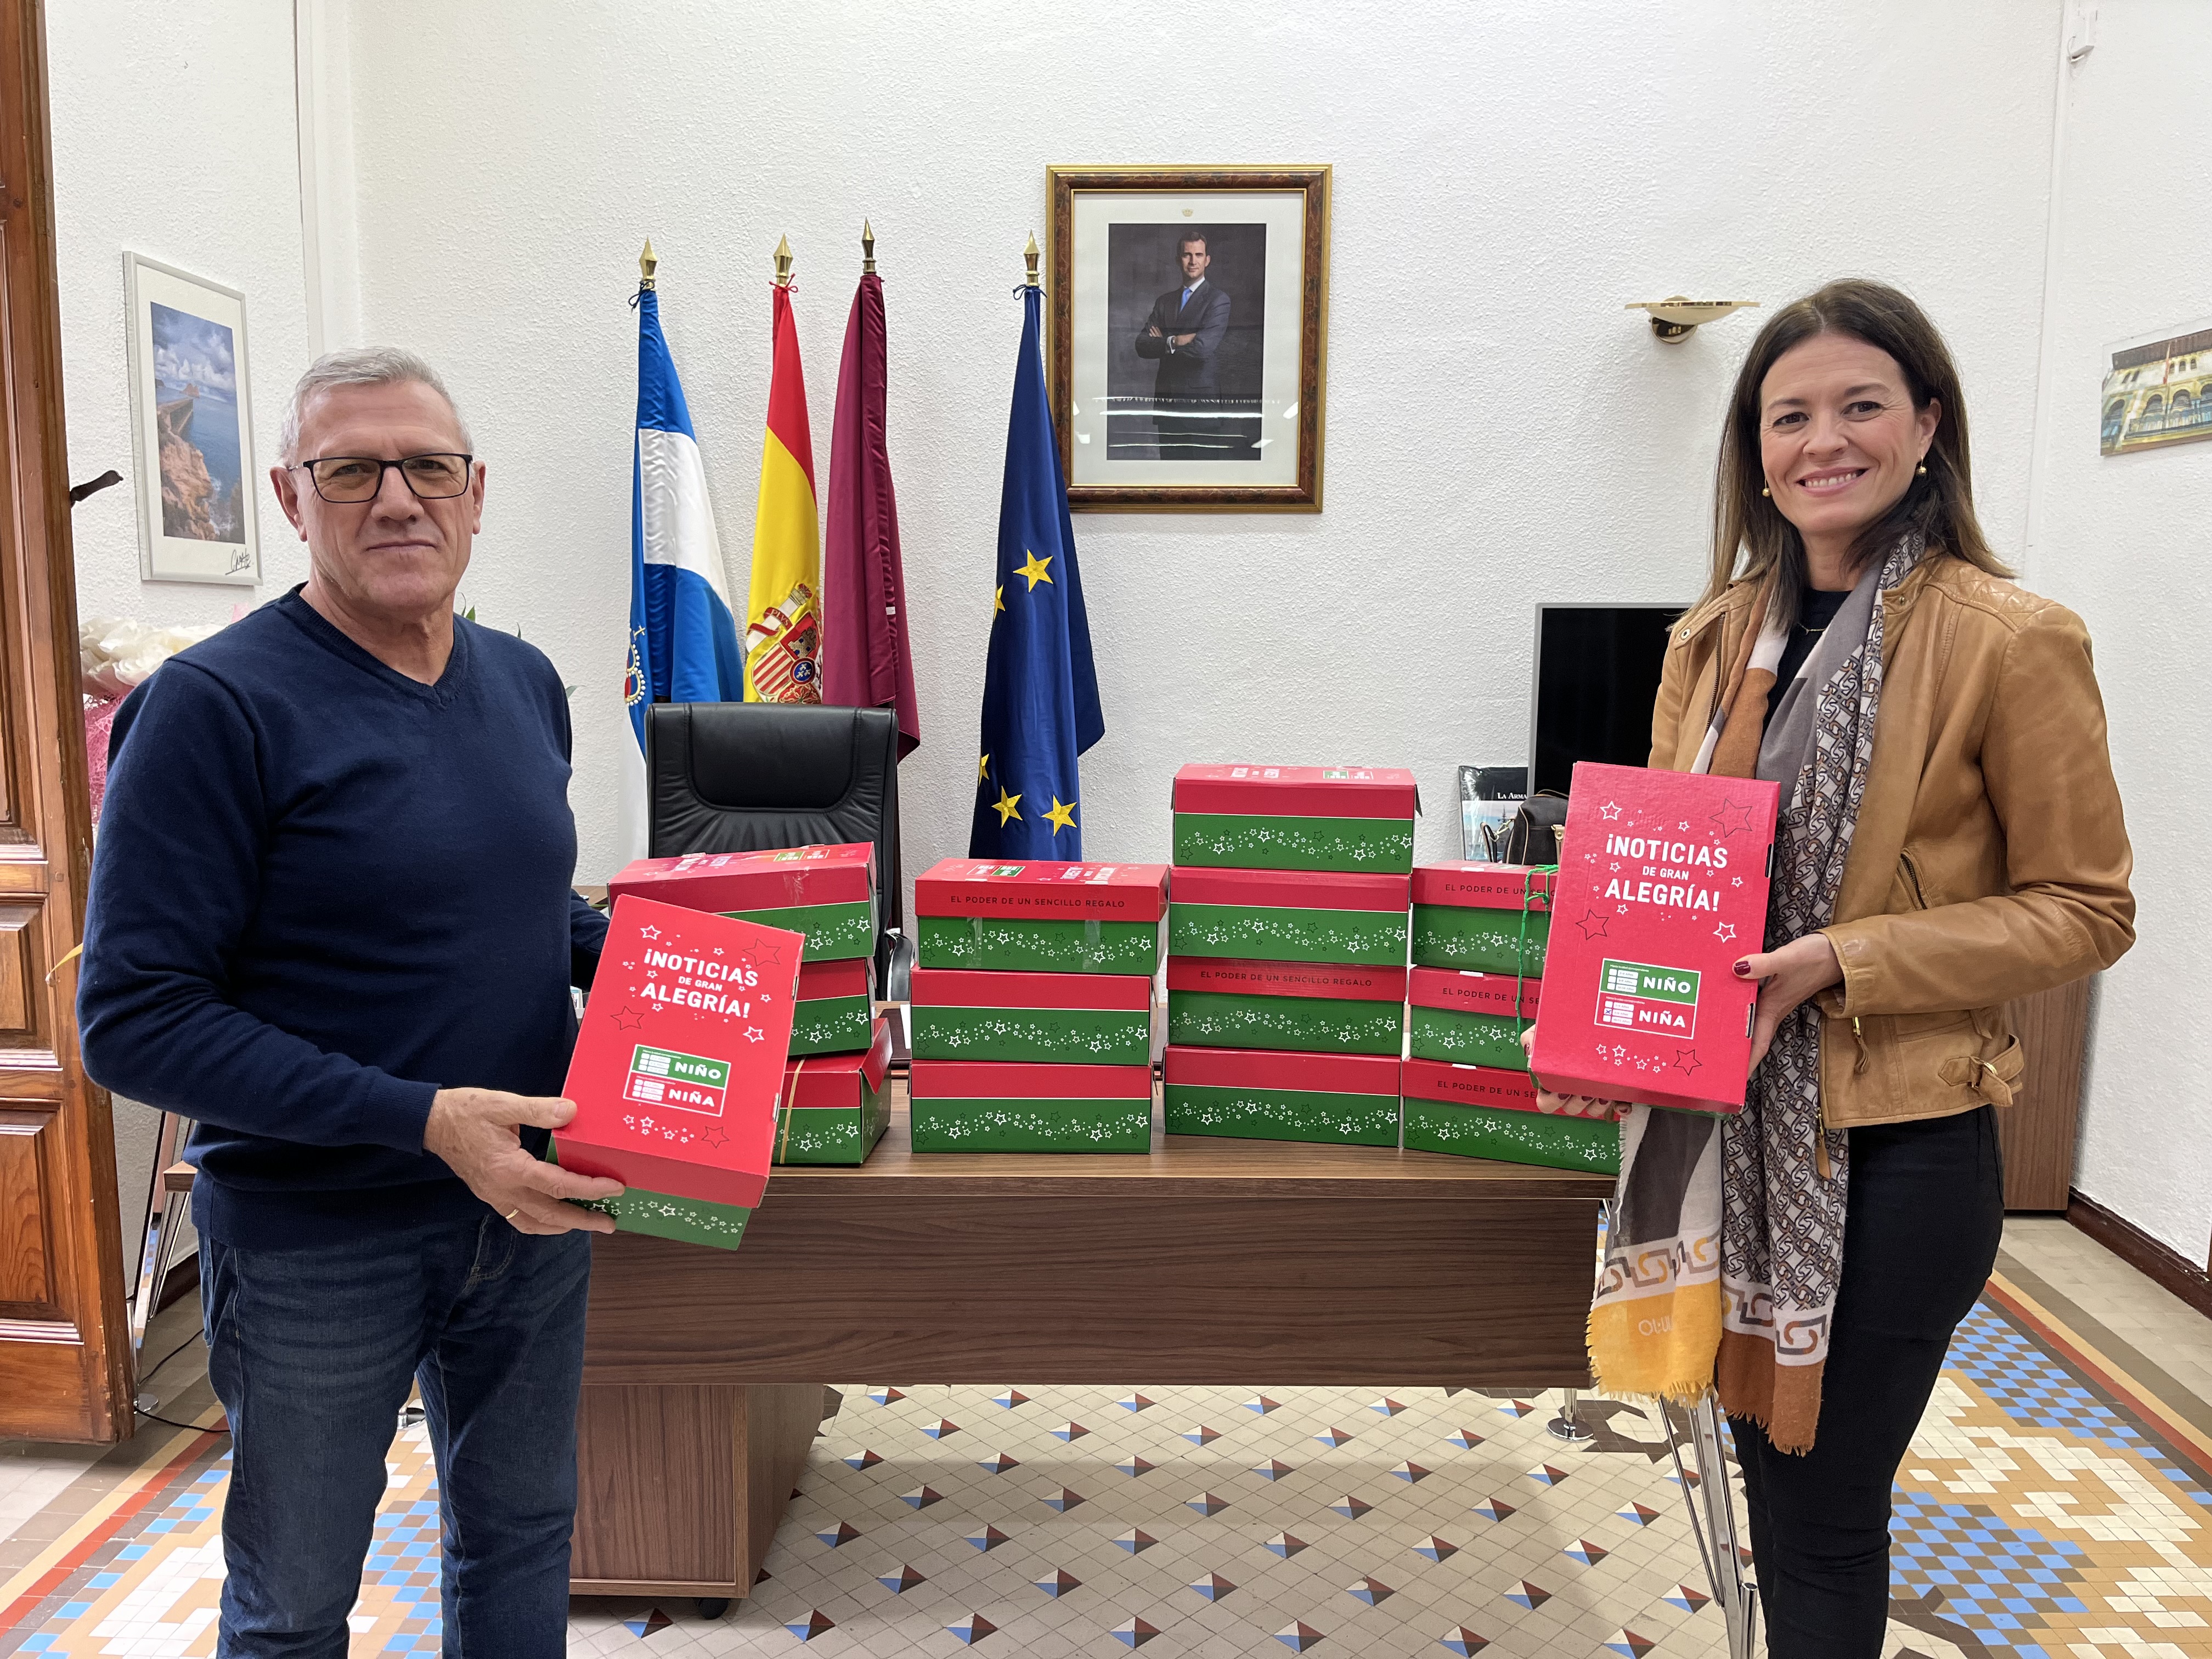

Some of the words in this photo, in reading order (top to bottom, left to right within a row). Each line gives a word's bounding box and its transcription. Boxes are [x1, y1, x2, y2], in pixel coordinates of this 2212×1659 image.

[1606, 833, 1728, 868] ¡NOTICIAS
[1642, 866, 1657, 877] DE
[1660, 868, 1690, 881] GRAN
[1460, 885, 1492, 893] PODER
[1605, 878, 1720, 911] ALEGRÍA!
[644, 948, 758, 986] ¡NOTICIAS
[678, 976, 692, 985] DE
[695, 979, 723, 991] GRAN
[1215, 972, 1246, 980] PODER
[1283, 975, 1329, 984] SENCILLO
[1333, 978, 1372, 986] REGALO
[1643, 976, 1691, 994] NIÑO
[640, 983, 750, 1019] ALEGRÍA!
[1458, 989, 1491, 1000] PODER
[1494, 993, 1508, 1001] DE
[1639, 1010, 1686, 1028] NIÑA
[674, 1062, 721, 1080] NIÑO
[1437, 1080, 1448, 1088] EL
[1452, 1082, 1486, 1092] PODER
[668, 1088, 715, 1107] NIÑA
